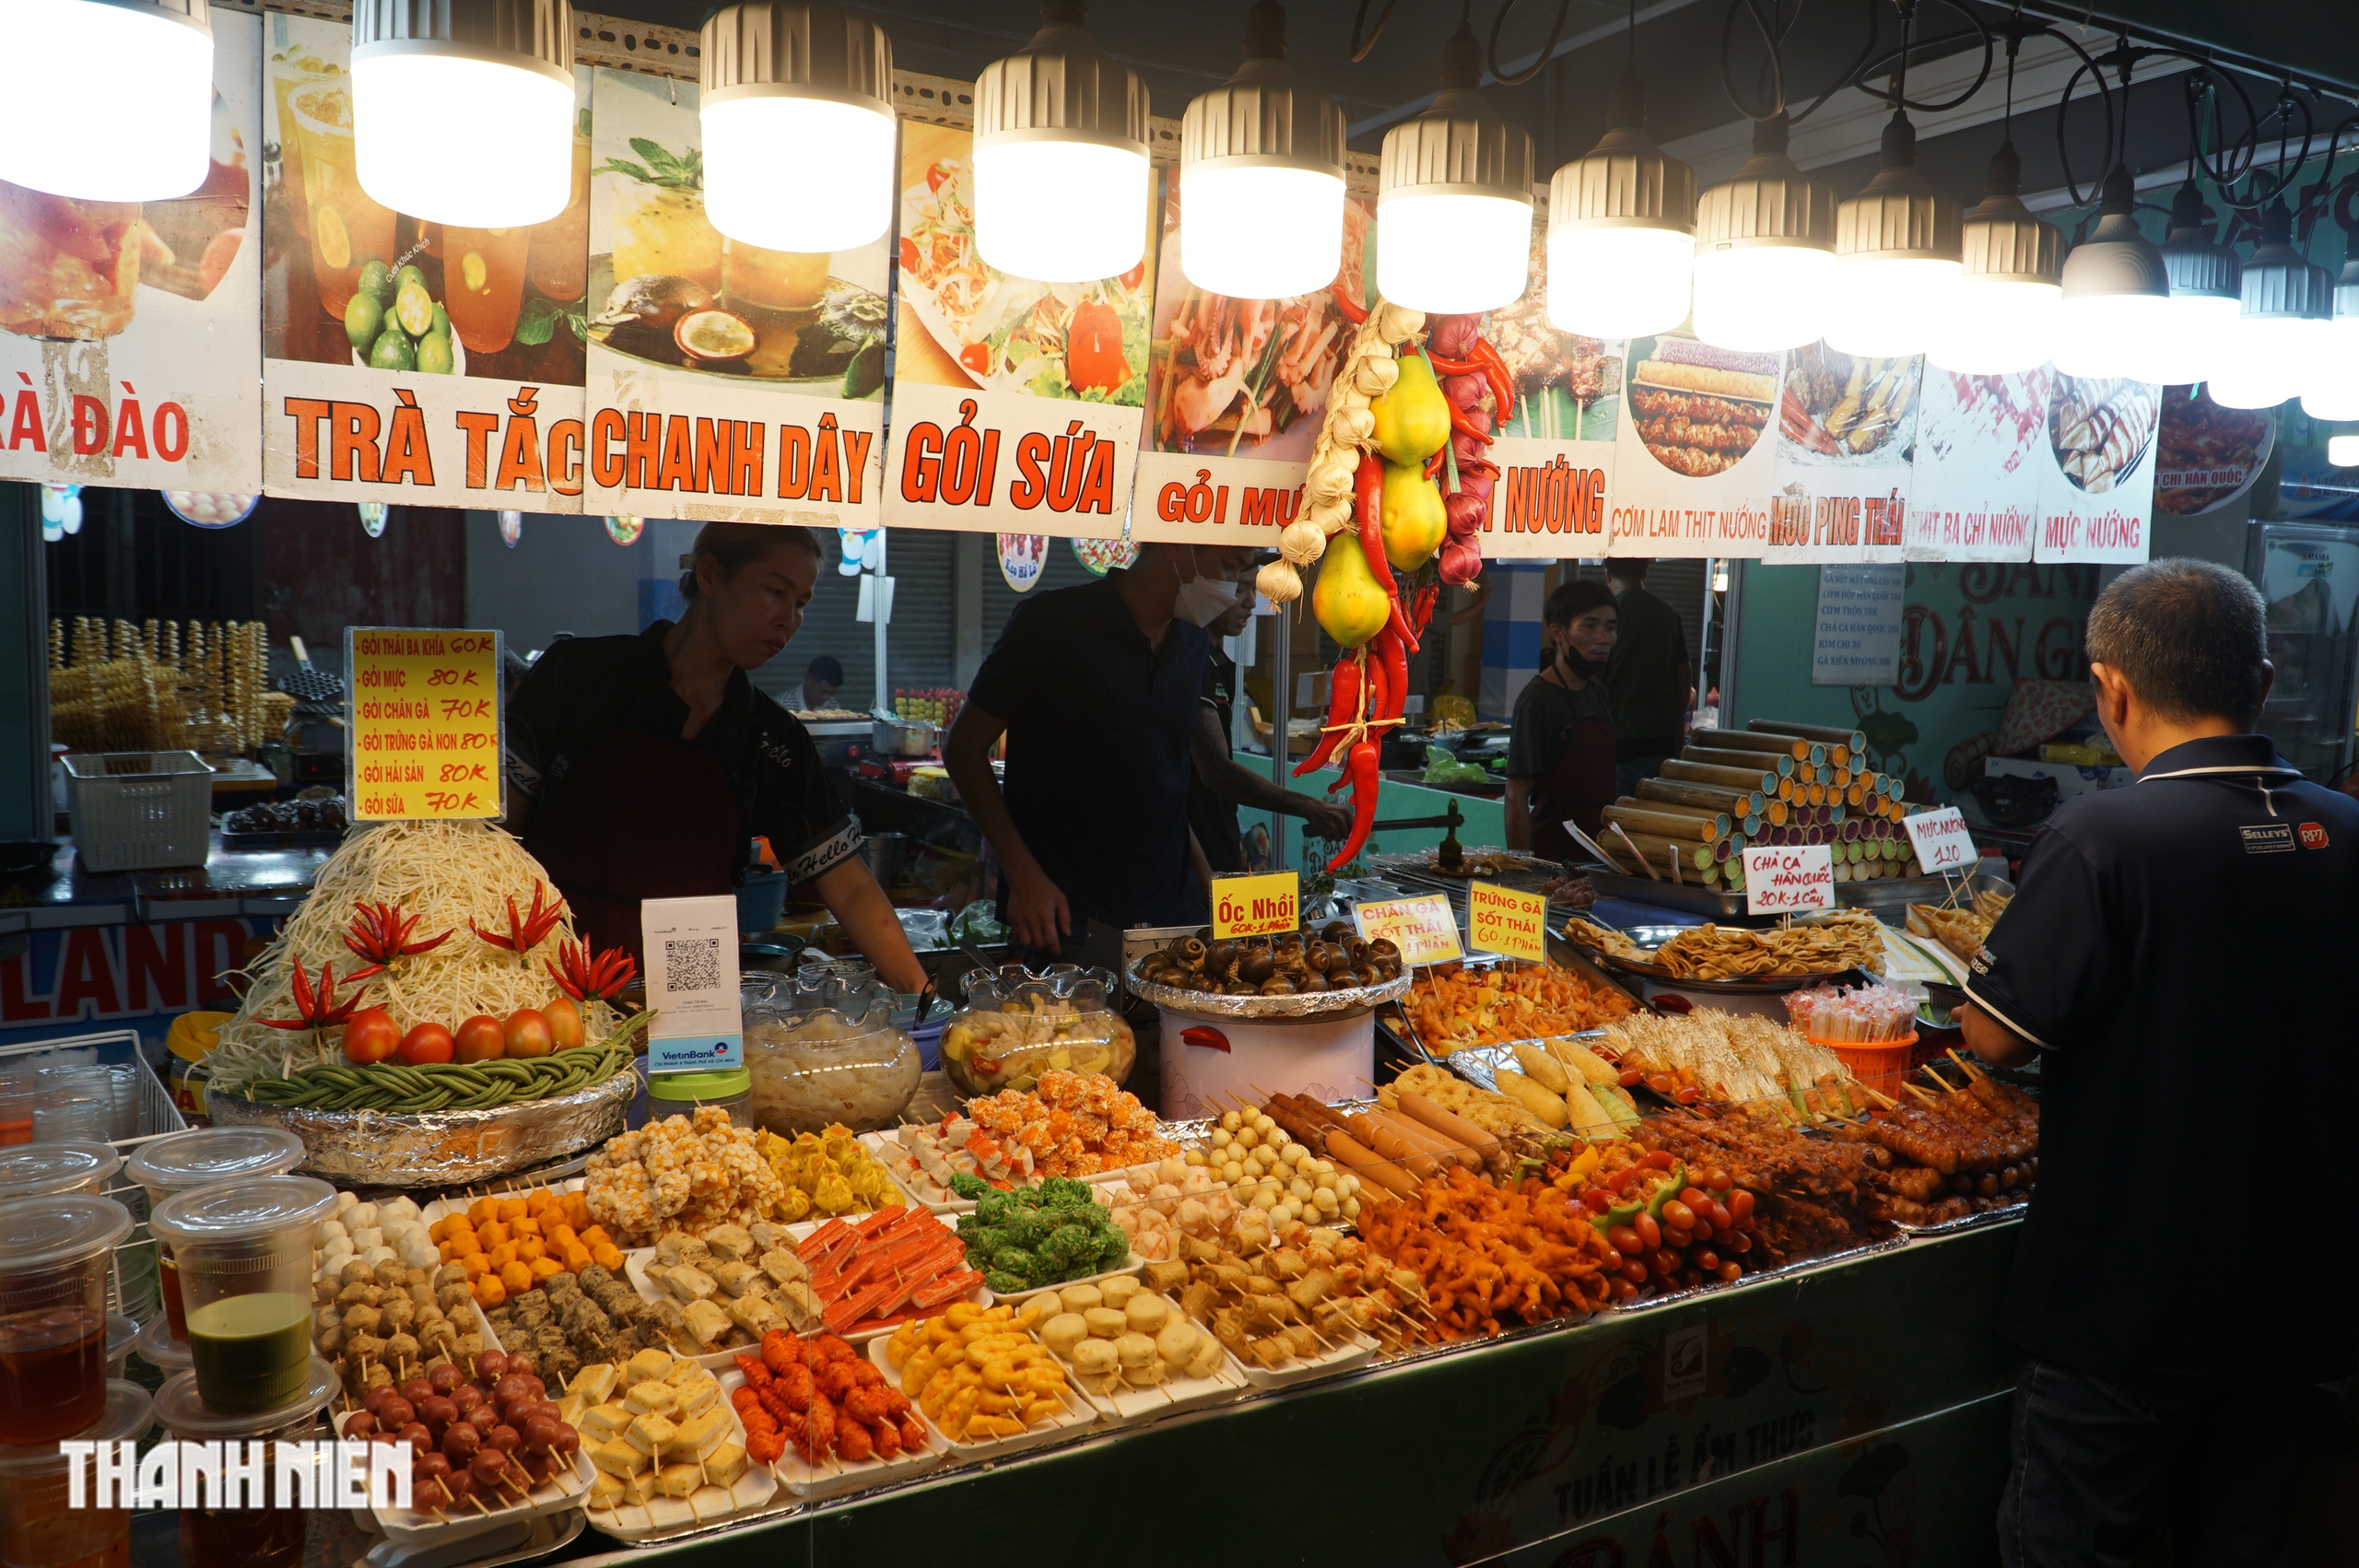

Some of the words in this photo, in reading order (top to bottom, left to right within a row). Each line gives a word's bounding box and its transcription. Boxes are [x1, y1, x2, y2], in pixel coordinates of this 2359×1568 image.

[70, 381, 190, 462] ĐÀO
[285, 388, 435, 487] TRÀ
[456, 387, 583, 497] TẮC
[592, 408, 765, 498] CHANH
[778, 412, 873, 505] DÂY
[900, 399, 1001, 507] GỎI
[1010, 420, 1115, 515] SỨA
[2163, 472, 2184, 486] CHI
[2185, 470, 2208, 485] HÀN
[2212, 465, 2243, 484] QUỐC
[1157, 469, 1229, 524] GỎI
[1239, 484, 1307, 533] MỰ
[1505, 453, 1605, 534] NƯỚNG
[1613, 505, 1644, 538] CƠM
[1649, 510, 1679, 538] LAM
[1684, 510, 1715, 544] THỊT
[1719, 498, 1766, 540] NƯỚNG
[1768, 497, 1811, 545] MOO
[1814, 497, 1860, 545] PING
[1864, 488, 1905, 545] THÁI
[1943, 512, 1960, 545] BA
[1964, 500, 1989, 546] CHỈ
[2045, 510, 2081, 555] MỰC
[2085, 509, 2140, 549] NƯỚNG
[1822, 606, 1840, 614] CƠM
[1842, 605, 1862, 617] TRỘN
[361, 632, 381, 655] GỎI
[382, 633, 405, 655] THÁI
[406, 638, 419, 655] BA
[422, 633, 445, 655] KHÍA
[1819, 640, 1835, 649] KIM
[1837, 640, 1850, 649] CHI
[362, 664, 381, 687] GỎI
[383, 668, 405, 692] MỰC
[362, 696, 381, 719] GỎI
[383, 697, 412, 719] CHÂN
[415, 697, 429, 719] GÀ
[363, 729, 381, 751] GỎI
[384, 730, 416, 751] TRỨNG
[418, 730, 433, 750] GÀ
[436, 733, 457, 751] NON
[364, 760, 382, 783] GỎI
[385, 760, 402, 782] HẢI
[405, 759, 424, 782] SẢN
[439, 763, 489, 783] 80K
[365, 791, 382, 814] GỎI
[386, 793, 405, 814] SỨA
[2301, 829, 2323, 843] RP7
[798, 840, 849, 875] Hello
[1783, 850, 1805, 870] CÁ
[1934, 845, 1960, 865] 120
[1219, 894, 1244, 923] Ốc
[1252, 894, 1294, 919] Nhồi
[1363, 904, 1411, 919] CHÂN
[1415, 898, 1440, 915] GÀ
[1473, 891, 1517, 909] TRỨNG
[1521, 900, 1542, 915] GÀ
[1370, 922, 1401, 939] SỐT
[1405, 919, 1442, 935] THÁI
[1477, 910, 1503, 927] SỐT
[1507, 919, 1535, 934] THÁI
[1414, 934, 1449, 954] PHẦN
[662, 1050, 715, 1059] VietinBank
[1555, 1456, 1637, 1526] TUẦN
[1647, 1434, 1680, 1497] LỄ
[1690, 1423, 1736, 1483] ẨM
